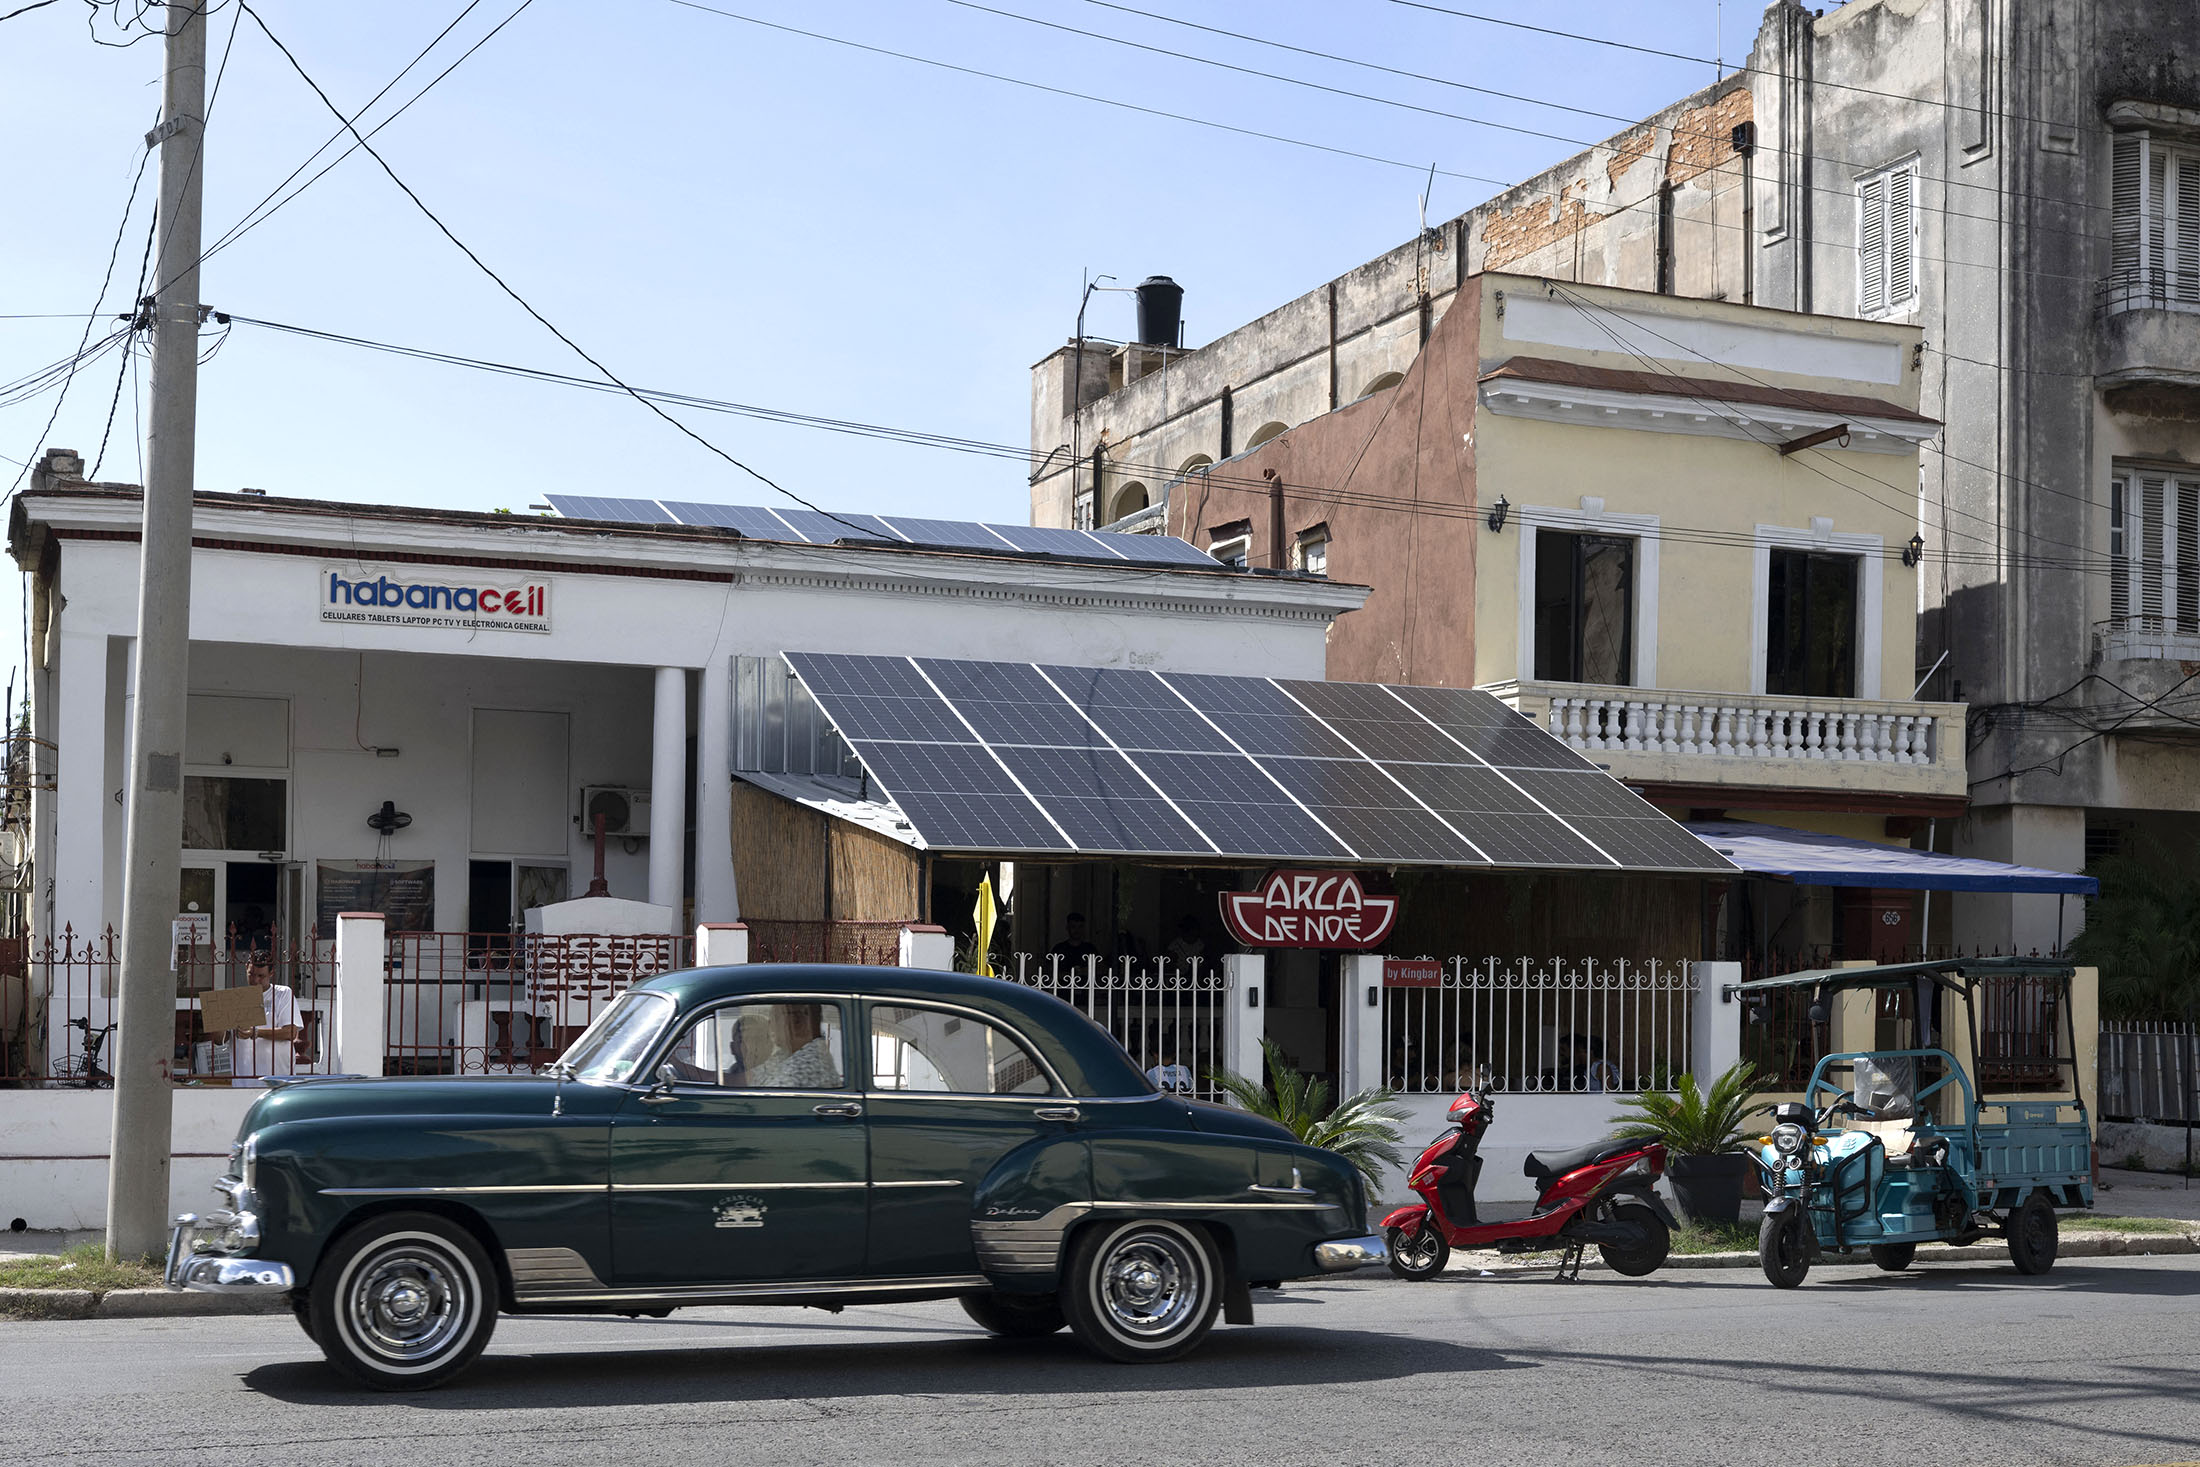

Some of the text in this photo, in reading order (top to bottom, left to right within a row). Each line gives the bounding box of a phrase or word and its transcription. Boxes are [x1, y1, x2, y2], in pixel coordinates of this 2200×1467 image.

[330, 572, 544, 616] habanacell
[322, 611, 366, 621] CELULARES
[368, 613, 401, 624] TABLETS
[402, 616, 431, 625] LAPTOP
[432, 618, 442, 626] PC
[444, 618, 455, 626] TV
[456, 619, 461, 627] Y
[1265, 874, 1362, 911] ARCA
[1265, 913, 1362, 943] DE NOÉ
[1387, 967, 1438, 981] by Kingbar
